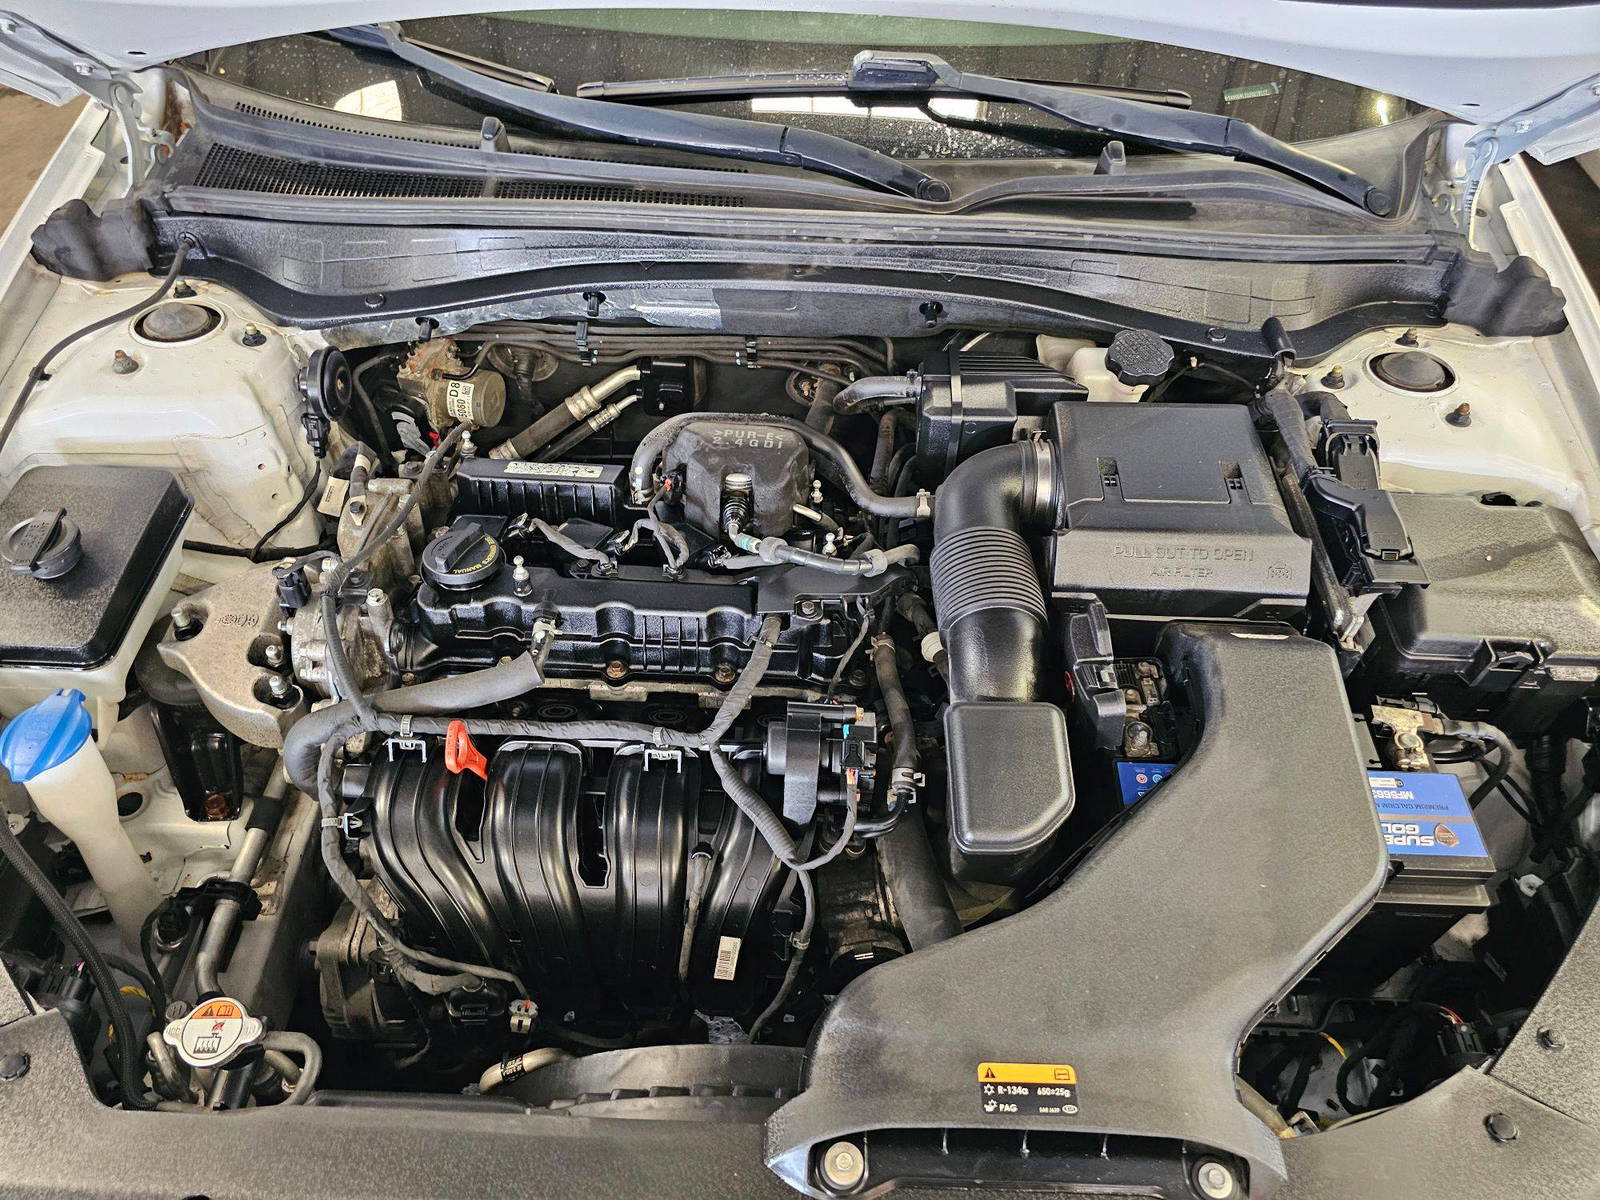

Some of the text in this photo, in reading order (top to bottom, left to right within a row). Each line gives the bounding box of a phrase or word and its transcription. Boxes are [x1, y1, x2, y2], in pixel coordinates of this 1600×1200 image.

[1113, 545, 1254, 562] PULL OUT TO OPEN
[1381, 823, 1420, 834] GOL
[1383, 834, 1436, 847] SUPE
[999, 1103, 1019, 1113] PAG
